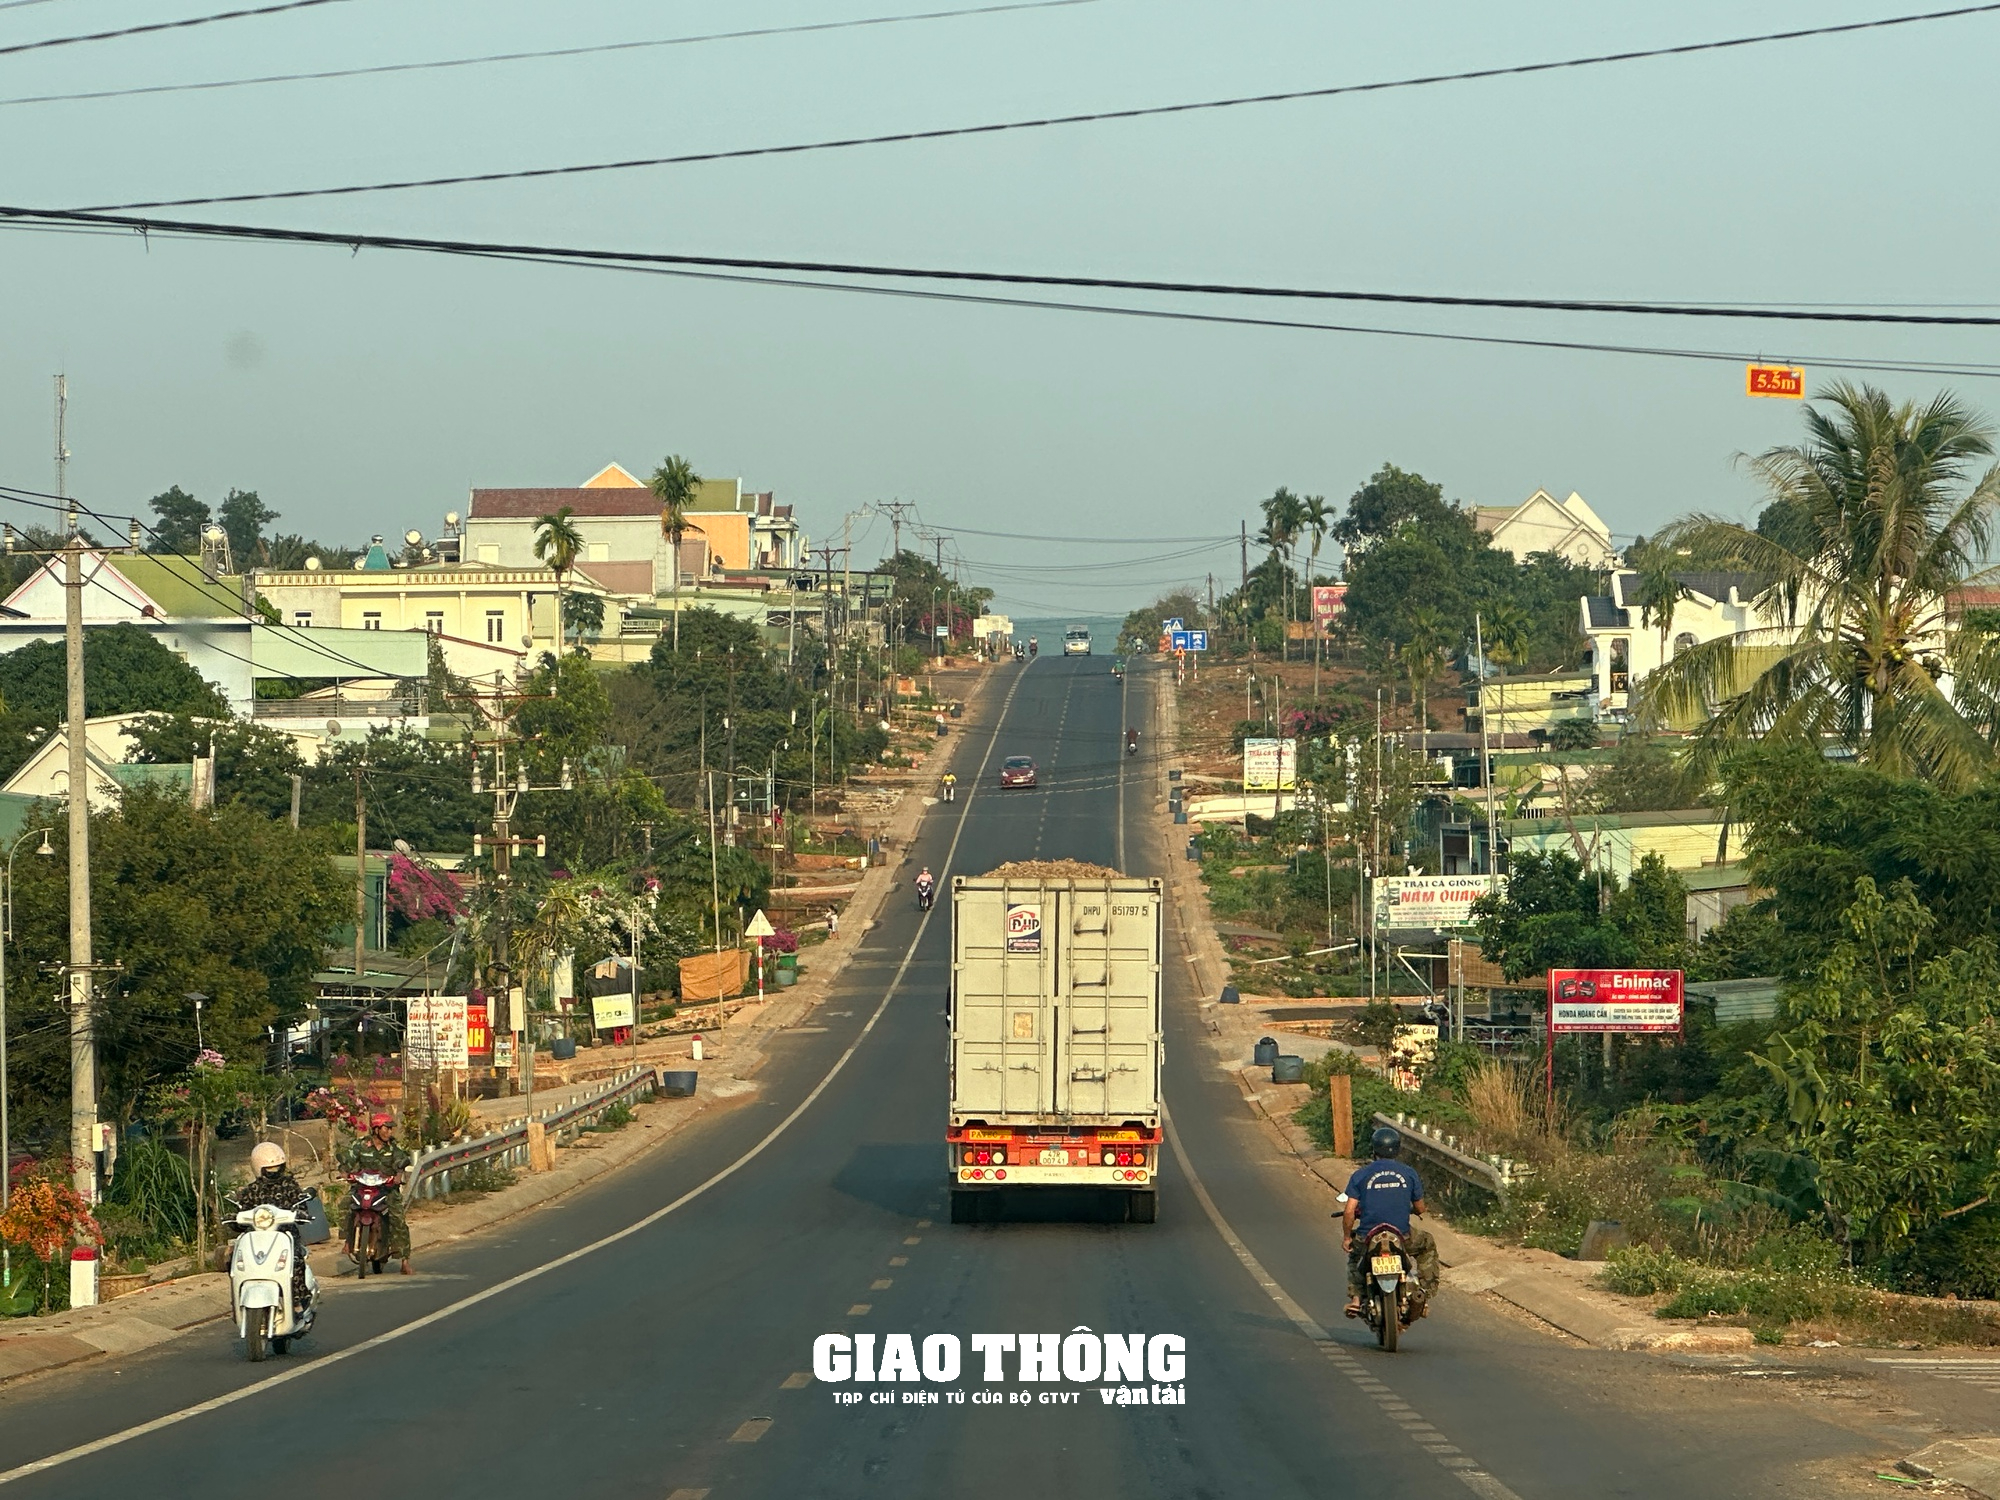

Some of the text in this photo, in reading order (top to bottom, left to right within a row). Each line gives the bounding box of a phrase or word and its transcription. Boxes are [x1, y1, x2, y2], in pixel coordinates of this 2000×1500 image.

[1757, 371, 1796, 390] 5.5m
[1083, 906, 1148, 916] DHPU 851797 5
[1613, 974, 1671, 988] Enimac
[1558, 1010, 1576, 1018] HONDA
